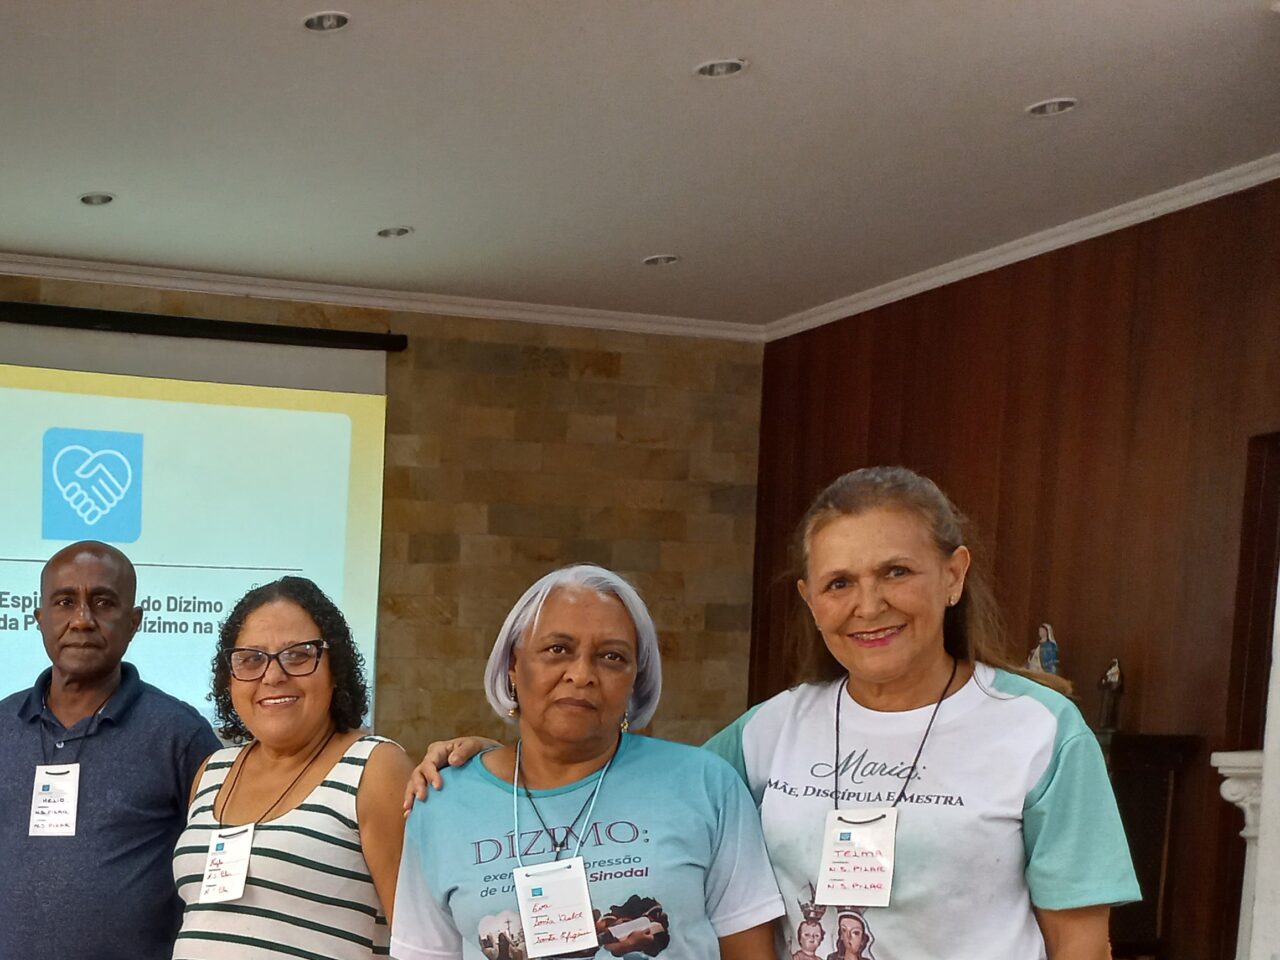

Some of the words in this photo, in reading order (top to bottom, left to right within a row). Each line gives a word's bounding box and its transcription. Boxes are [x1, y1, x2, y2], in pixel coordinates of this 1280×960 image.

[166, 596, 223, 613] Dízimo
[192, 621, 214, 634] na
[480, 888, 497, 898] de
[589, 866, 649, 883] Sinodal
